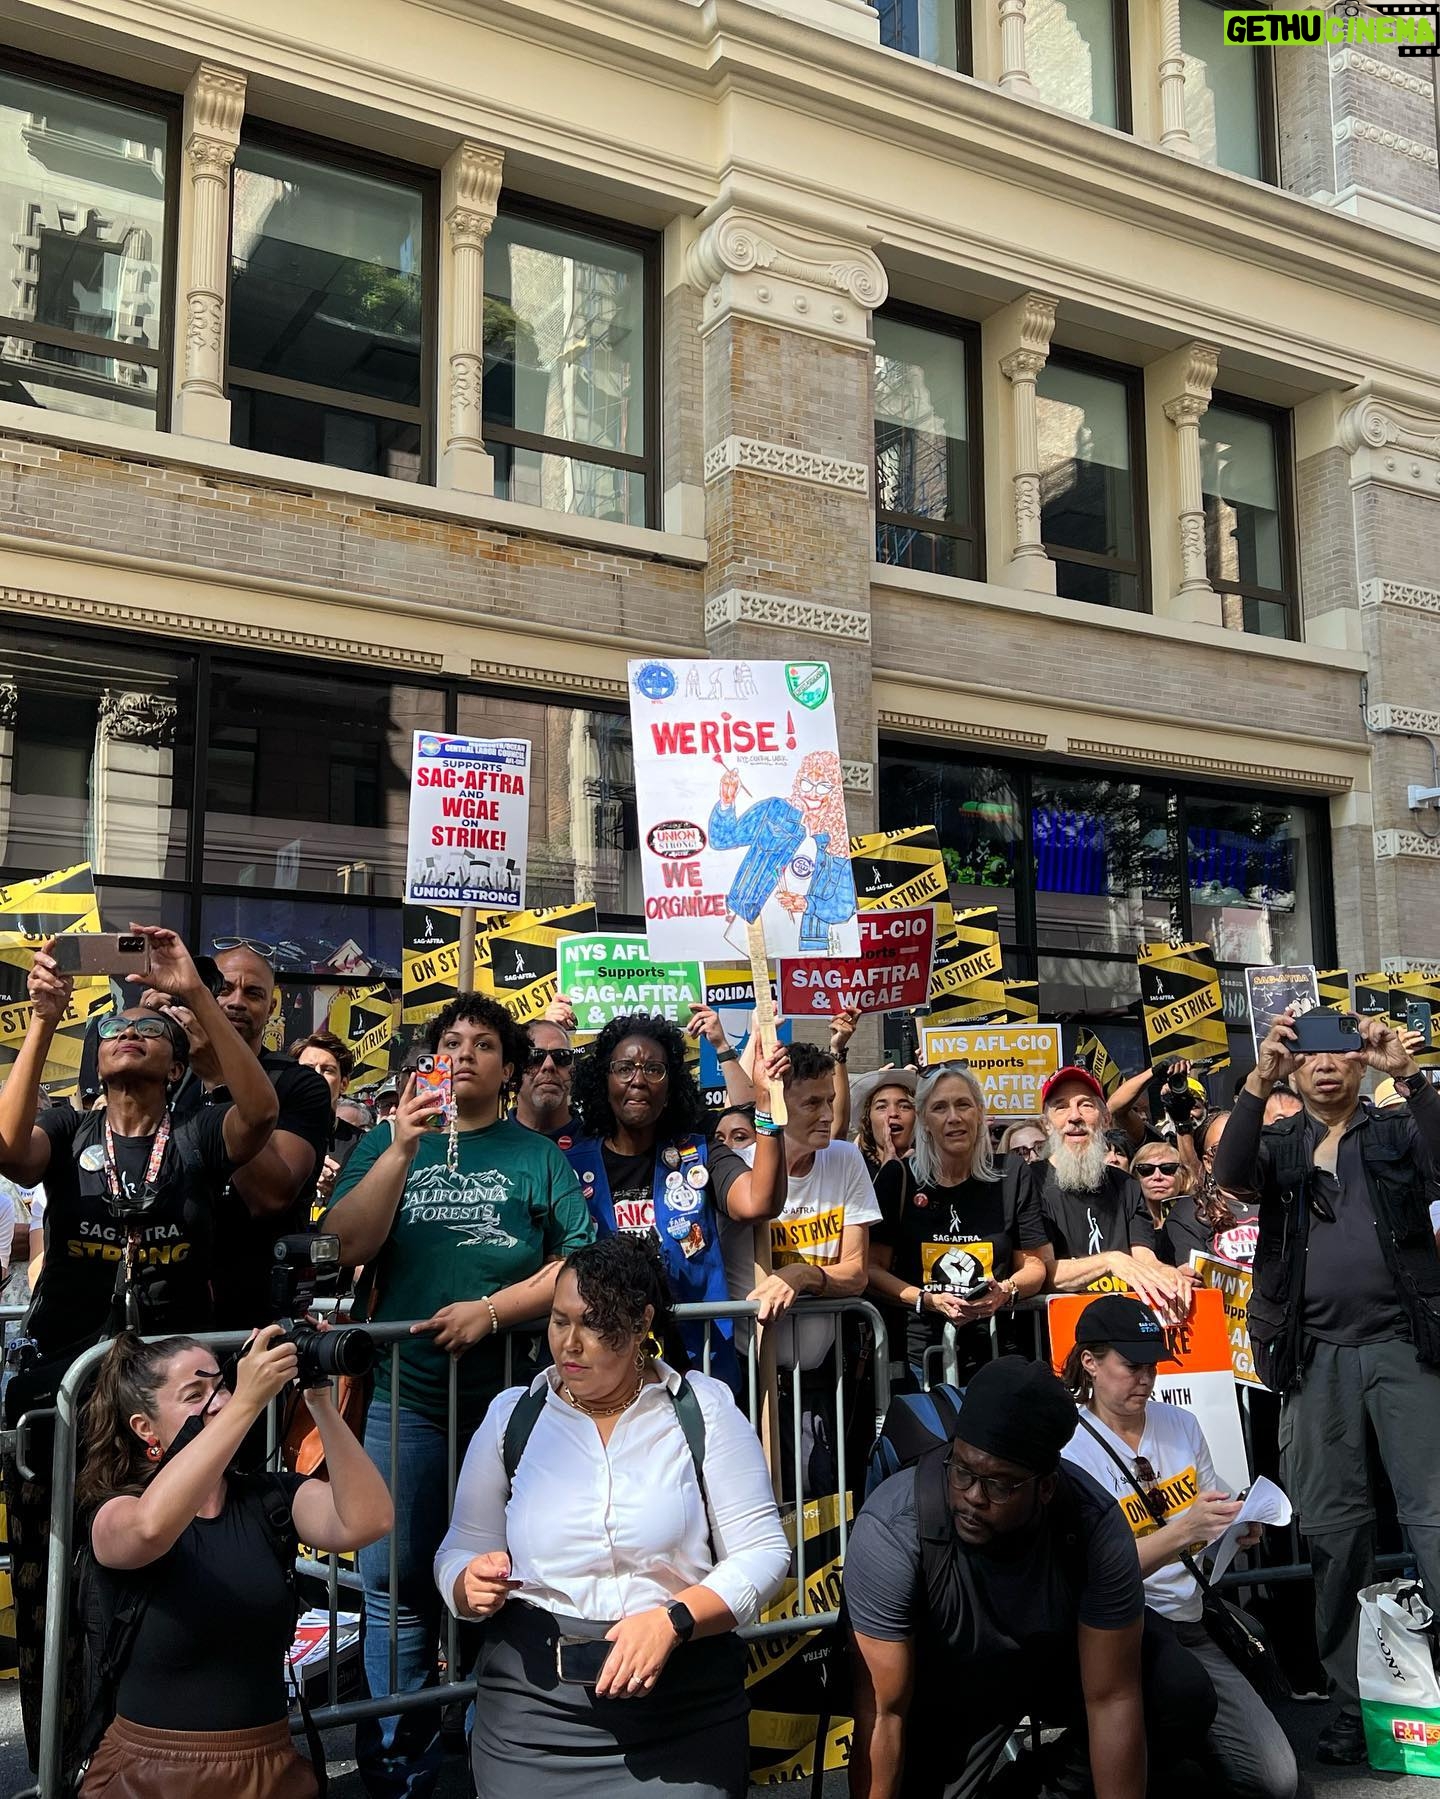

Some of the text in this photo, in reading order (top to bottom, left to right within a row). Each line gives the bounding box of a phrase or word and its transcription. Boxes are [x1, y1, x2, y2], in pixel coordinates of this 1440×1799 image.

[651, 722, 697, 755] WE
[445, 744, 526, 759] CENTRAL LABOR COUNCIL
[442, 760, 503, 772] SUPPORTS
[459, 790, 484, 799] AND
[441, 797, 500, 821] WGAE
[462, 819, 479, 828] ON
[431, 825, 507, 851] STRIKE!
[657, 830, 695, 841] UNION
[659, 841, 697, 849] STRONG!
[662, 862, 703, 888] WE
[413, 886, 517, 904] UNION STRONG
[889, 872, 941, 909] STRIKE
[859, 918, 928, 941] FL-CIO
[565, 943, 606, 963] NYS
[412, 957, 437, 983] ON
[597, 966, 666, 979] Supports
[791, 962, 921, 988] SAG-AFTRA
[944, 952, 996, 986] STRIKE
[568, 984, 695, 1005] SAG-AFTRA
[811, 985, 905, 1010] & WGAE
[587, 1005, 606, 1025] &
[1151, 1012, 1172, 1034] ON
[1170, 989, 1217, 1025] STRIKE
[932, 1034, 1052, 1053] NYS AFL-CIO
[408, 1203, 495, 1225] FORESTS
[790, 1214, 843, 1246] STRIKE
[1211, 1269, 1251, 1299] WNY
[1160, 1388, 1192, 1405] WITH
[1126, 1498, 1148, 1524] ON
[1393, 1721, 1425, 1742] B&H
